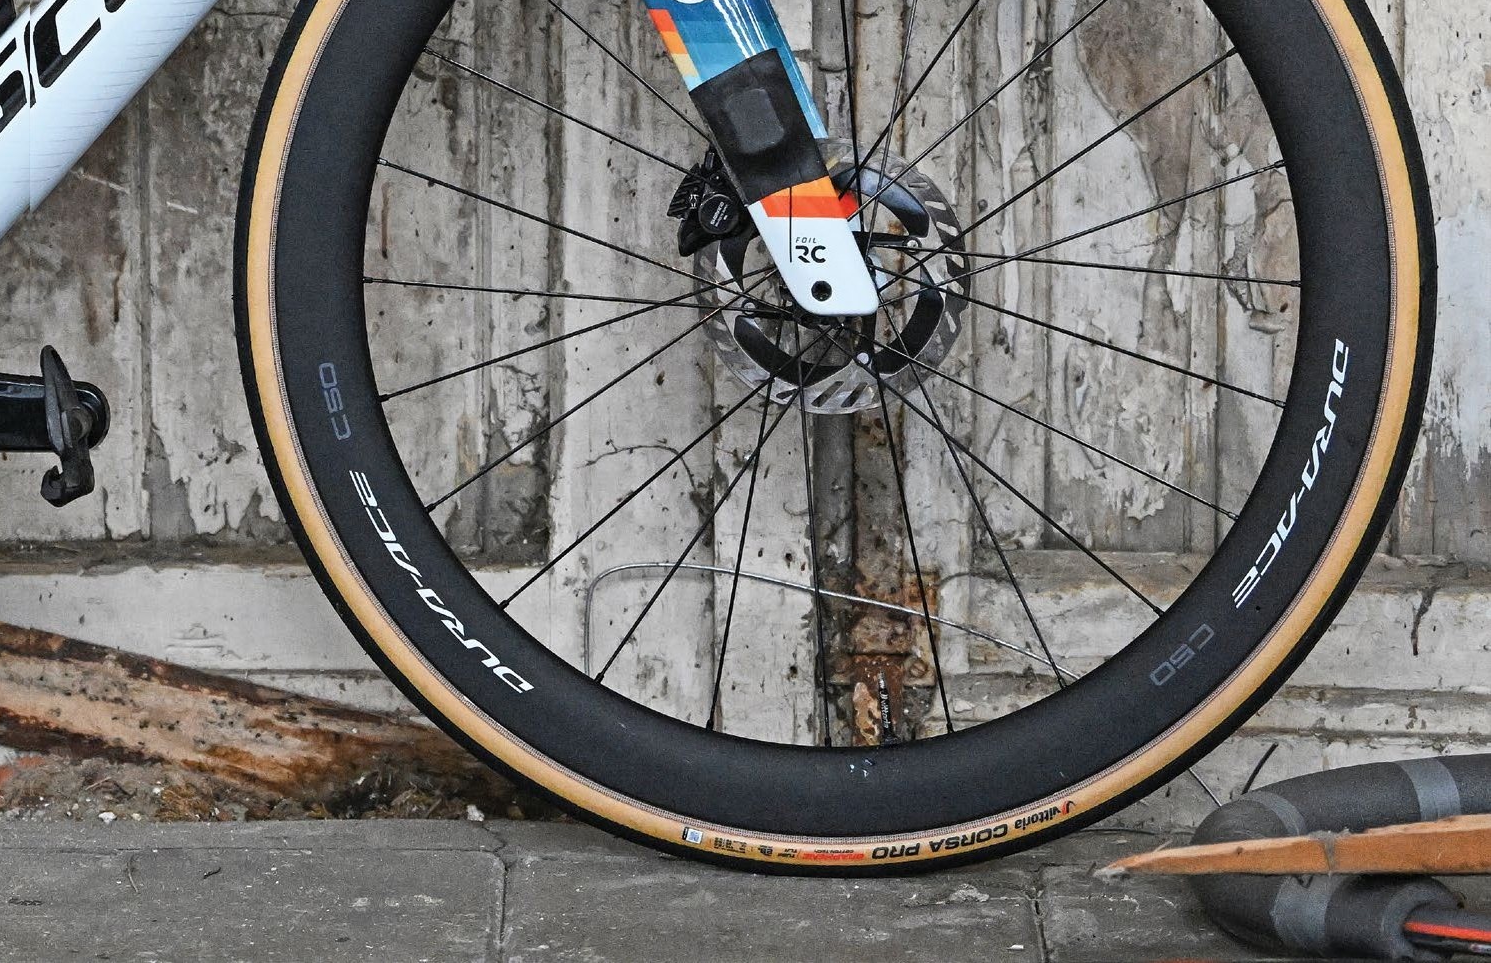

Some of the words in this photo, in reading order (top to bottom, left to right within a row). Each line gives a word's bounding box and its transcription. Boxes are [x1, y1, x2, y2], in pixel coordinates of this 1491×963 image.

[795, 236, 817, 244] FOIL
[795, 245, 827, 264] RC
[318, 362, 352, 441] C50
[1231, 338, 1350, 609] DURA-ACE
[349, 470, 535, 694] DURA-ACE
[1149, 623, 1215, 686] C50
[1013, 806, 1061, 833] vittoria
[870, 841, 921, 860] PRO
[929, 822, 1008, 854] CORSA
